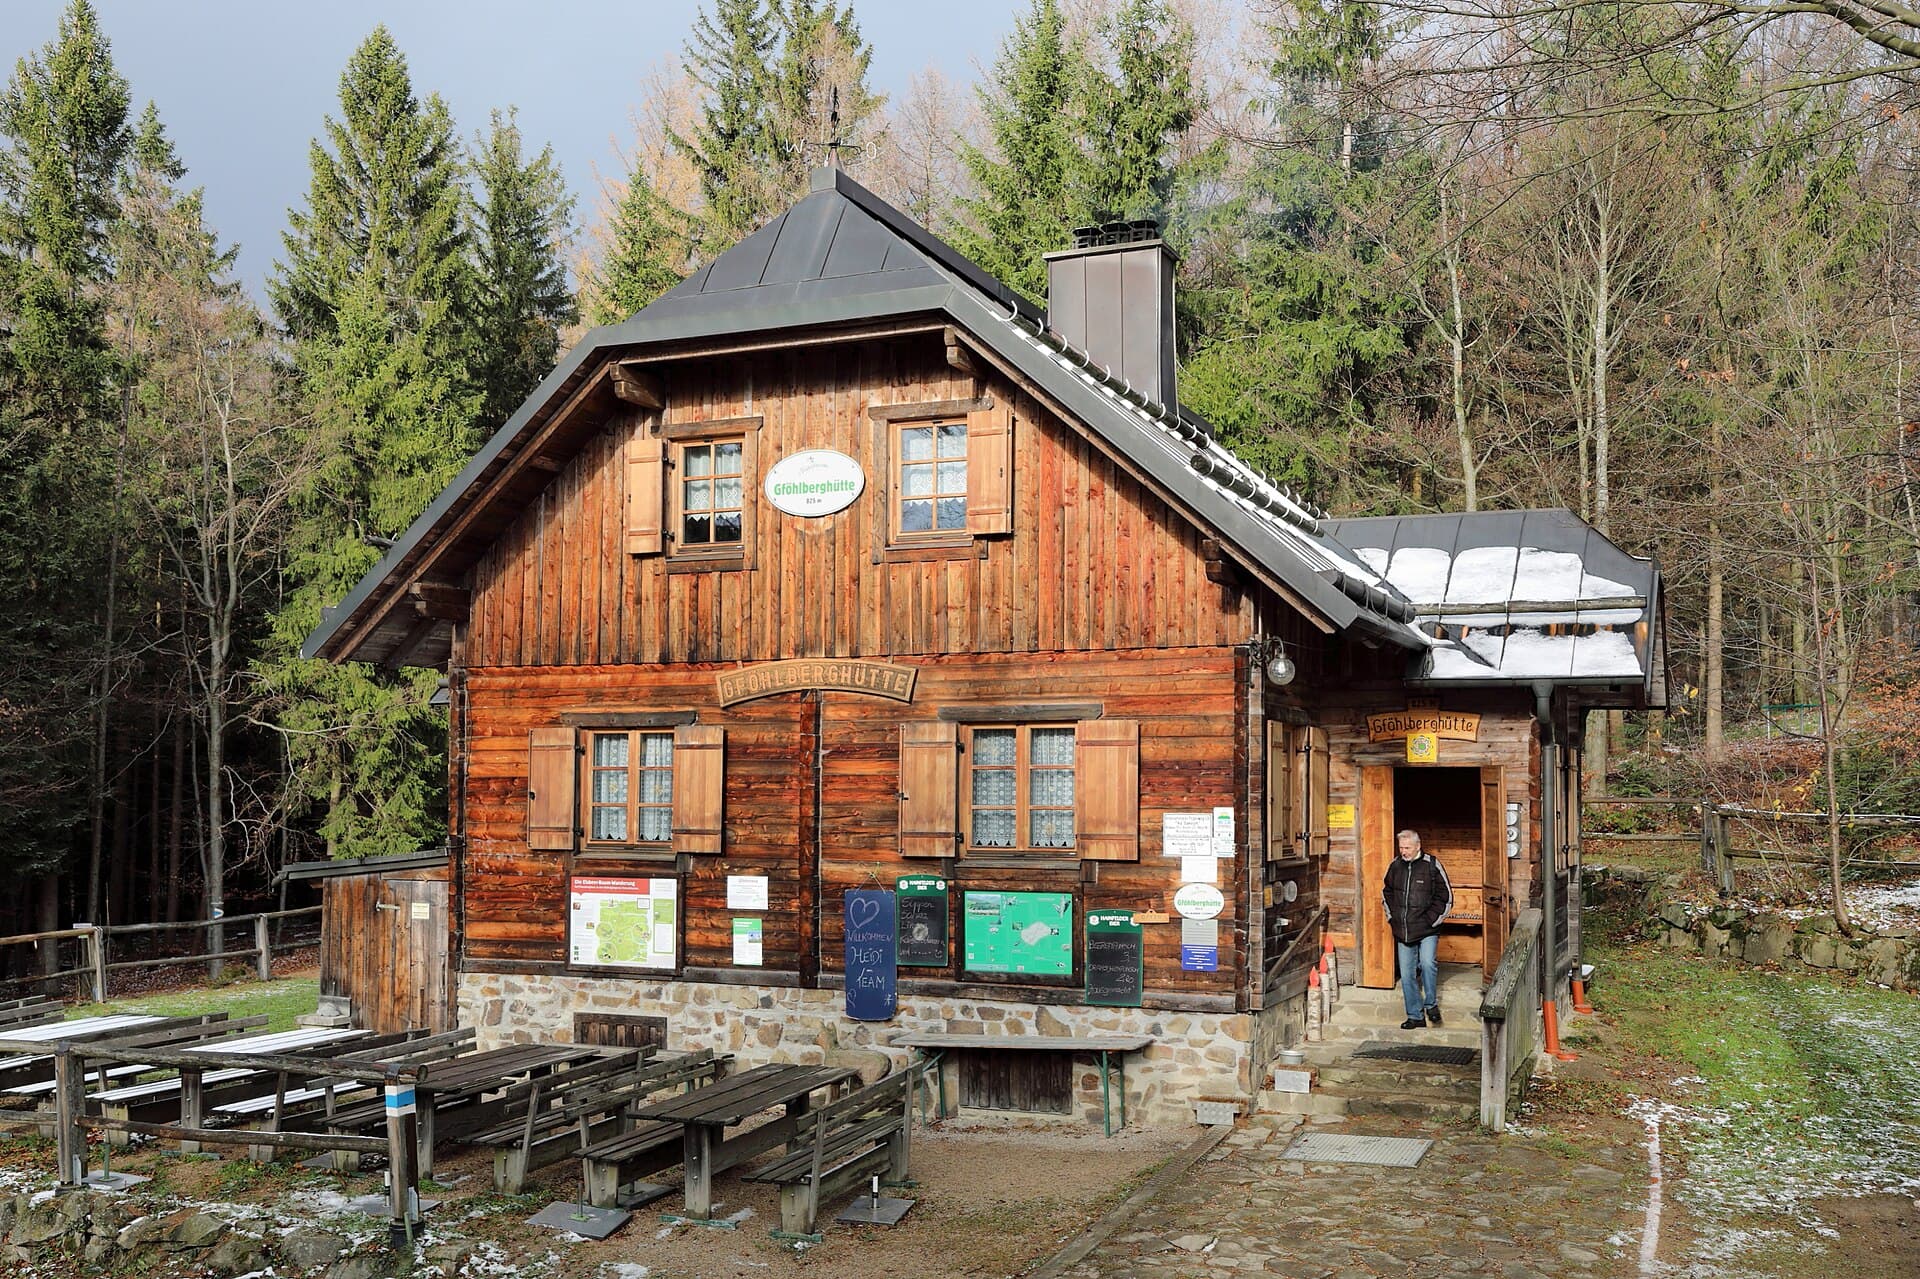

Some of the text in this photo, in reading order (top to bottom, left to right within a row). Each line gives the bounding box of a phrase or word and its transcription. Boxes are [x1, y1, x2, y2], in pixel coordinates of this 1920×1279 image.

[774, 479, 855, 495] Gföhlberghütte
[723, 664, 909, 698] GFÖHLBERGHÜTTE
[1372, 715, 1473, 733] Gföhlberghütte
[846, 929, 893, 943] WILLKOMMEN
